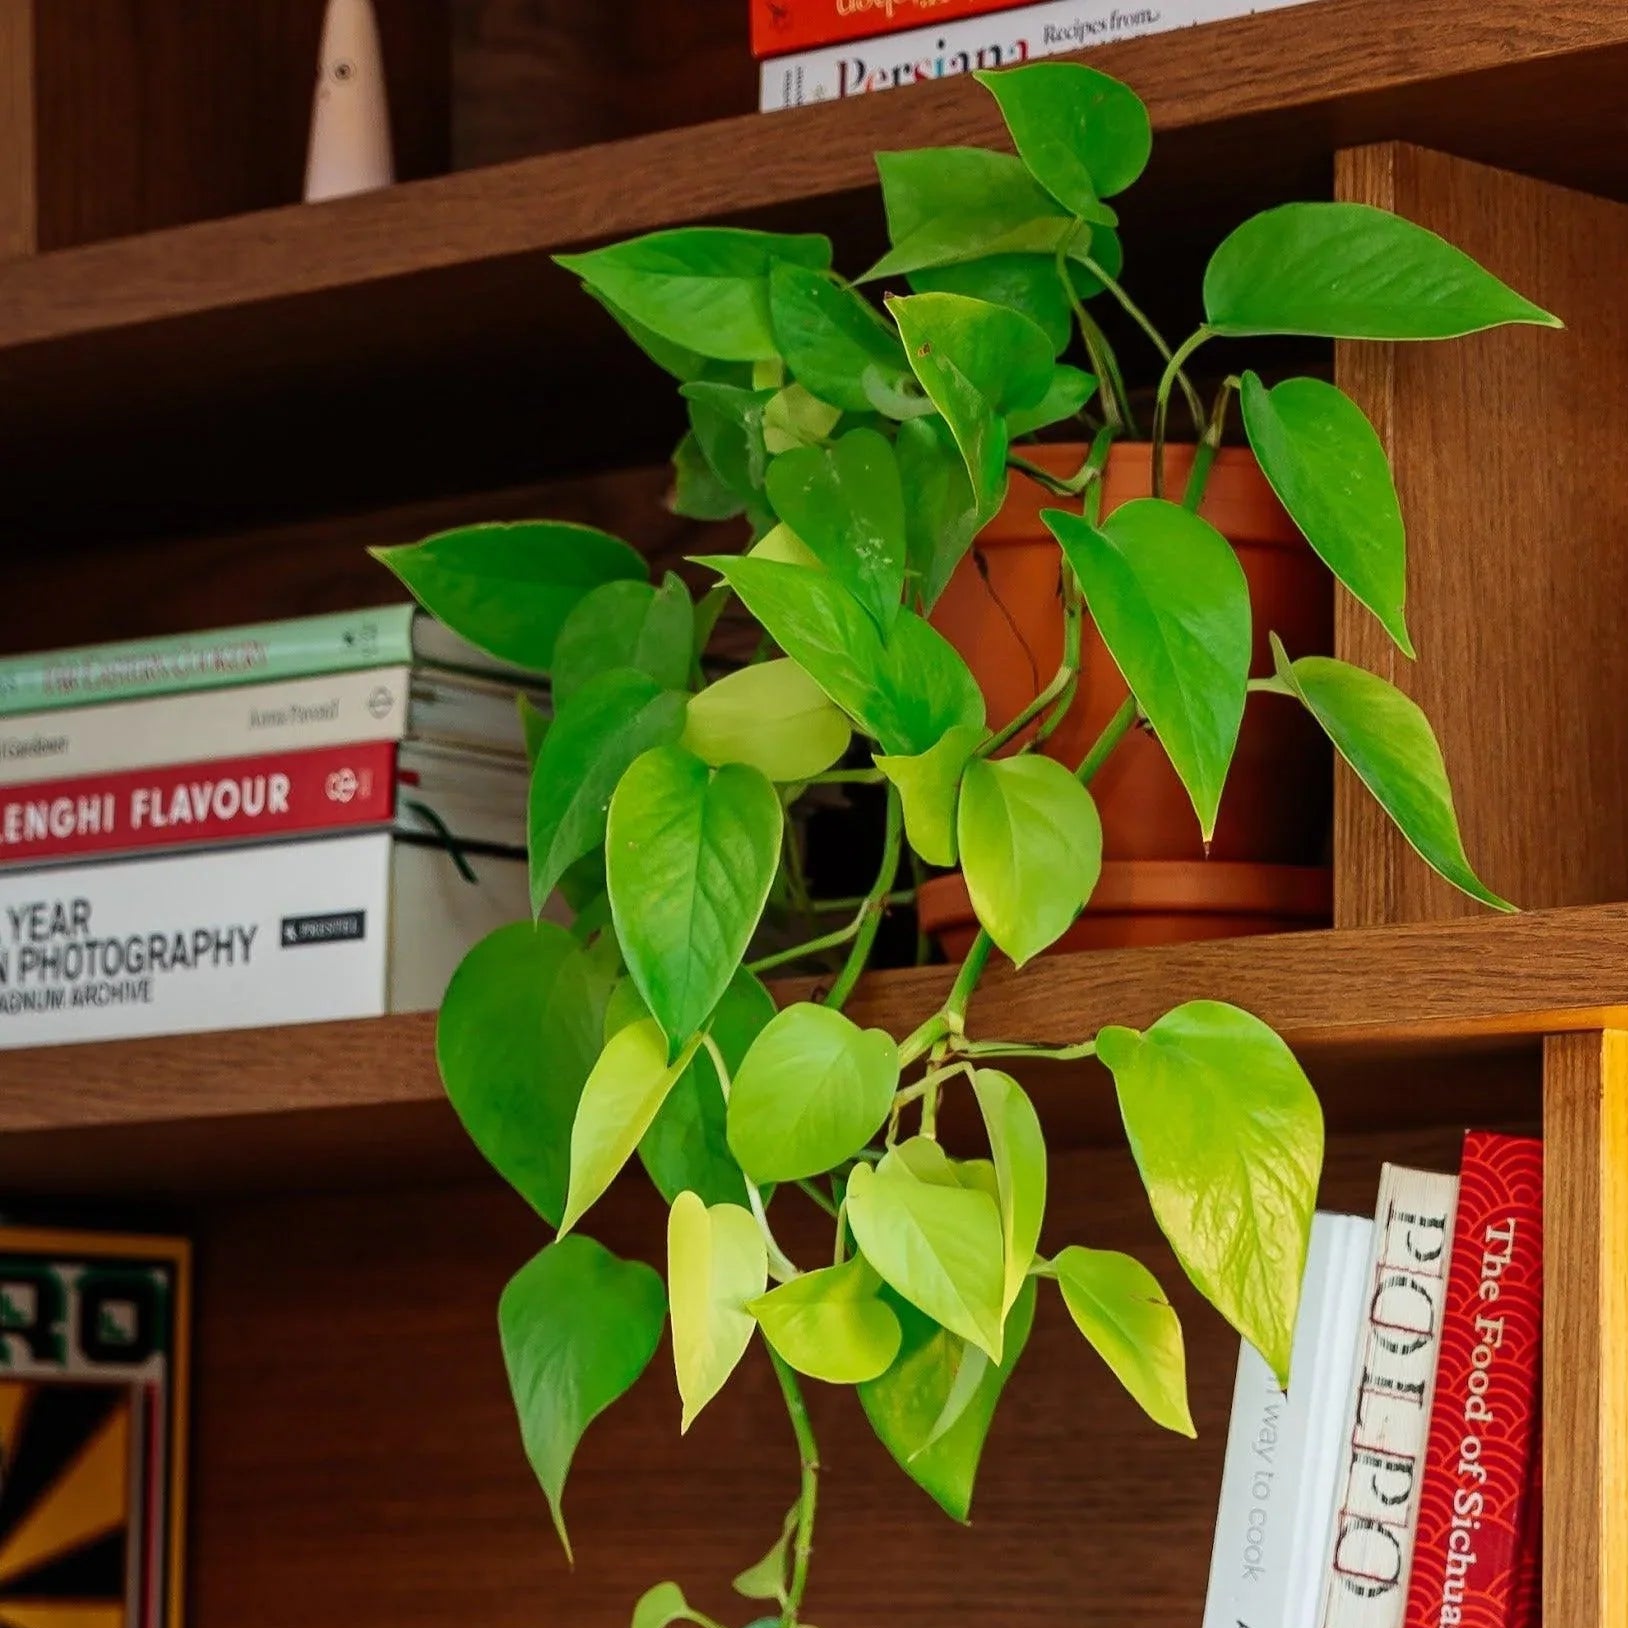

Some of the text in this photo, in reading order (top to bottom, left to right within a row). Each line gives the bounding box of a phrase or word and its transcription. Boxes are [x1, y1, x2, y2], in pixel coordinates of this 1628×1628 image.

[1043, 8, 1161, 44] Recipes from
[0, 772, 291, 844] ENGHI FLAVOUR
[6, 896, 92, 942] YEAR
[18, 924, 260, 984] PHOTOGRAPHY
[73, 976, 156, 1009] ARCHIVE
[1478, 1217, 1516, 1301] The
[1465, 1314, 1505, 1423] Food
[1252, 1404, 1280, 1464] way
[1458, 1434, 1488, 1485] of
[1252, 1470, 1275, 1501] to
[1242, 1507, 1268, 1582] cook
